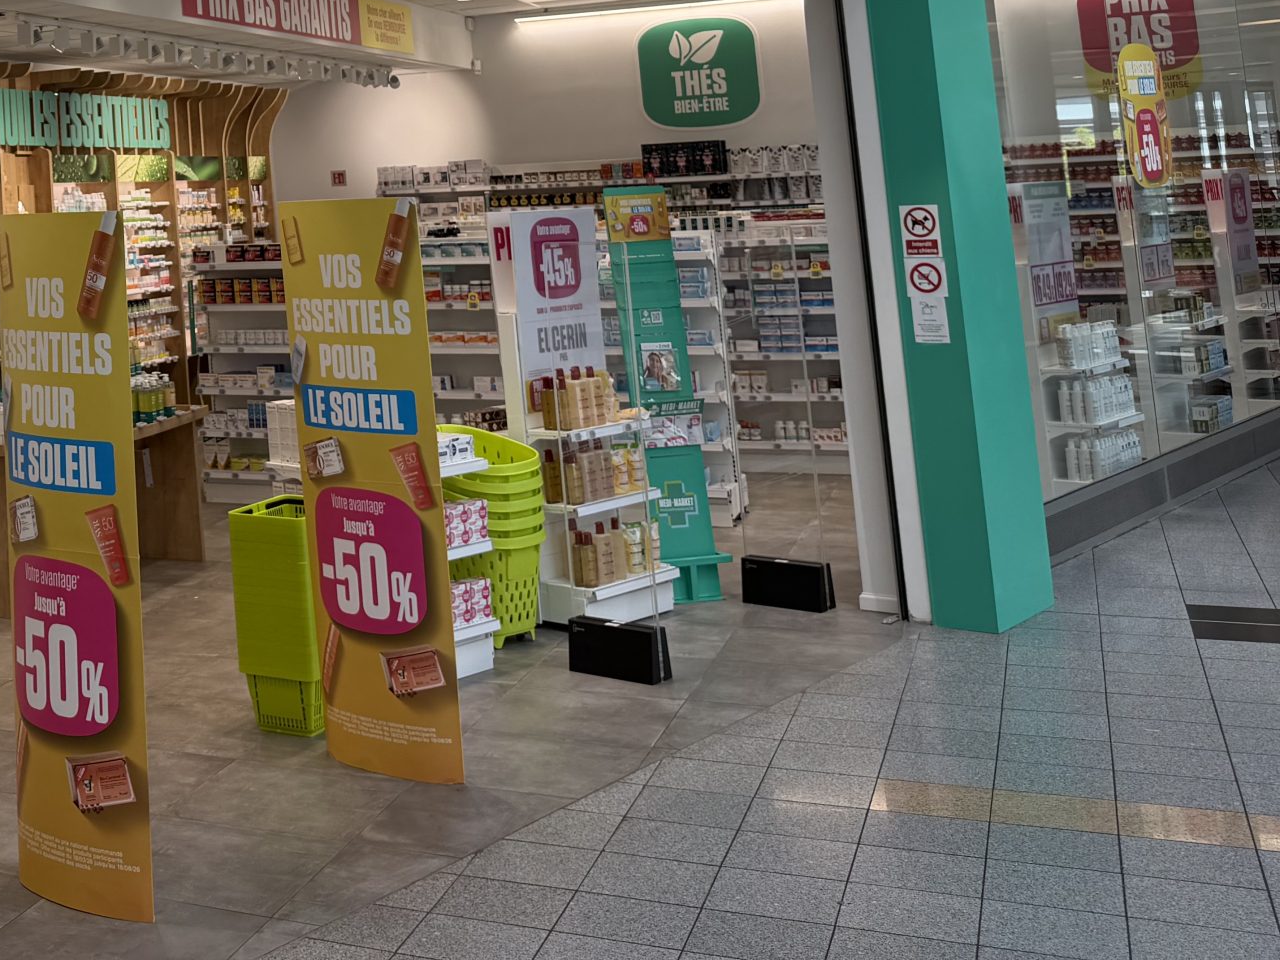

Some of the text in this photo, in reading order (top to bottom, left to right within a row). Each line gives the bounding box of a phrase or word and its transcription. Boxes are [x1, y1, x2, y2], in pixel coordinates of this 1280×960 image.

[1107, 12, 1174, 53] BAS
[671, 64, 728, 97] THÉS
[60, 92, 170, 149] ESSENTIELLES
[674, 96, 729, 114] BIEN-ÊTRE
[319, 253, 361, 289] VOS
[540, 248, 575, 287] -45%
[25, 276, 64, 319] VOS
[292, 297, 411, 336] ESSENTIELS
[3, 328, 112, 376] ESSENTIELS
[319, 343, 377, 380] POUR
[21, 384, 76, 429] POUR
[308, 388, 404, 431] LE SOLEIL
[12, 436, 102, 490] LE SOLEIL
[330, 492, 348, 510] Votre
[343, 516, 375, 537] Jusqu'à
[24, 562, 40, 587] Votre
[322, 537, 419, 625] -50%
[34, 591, 66, 617] Jusqu'à
[16, 615, 109, 725] -50%
